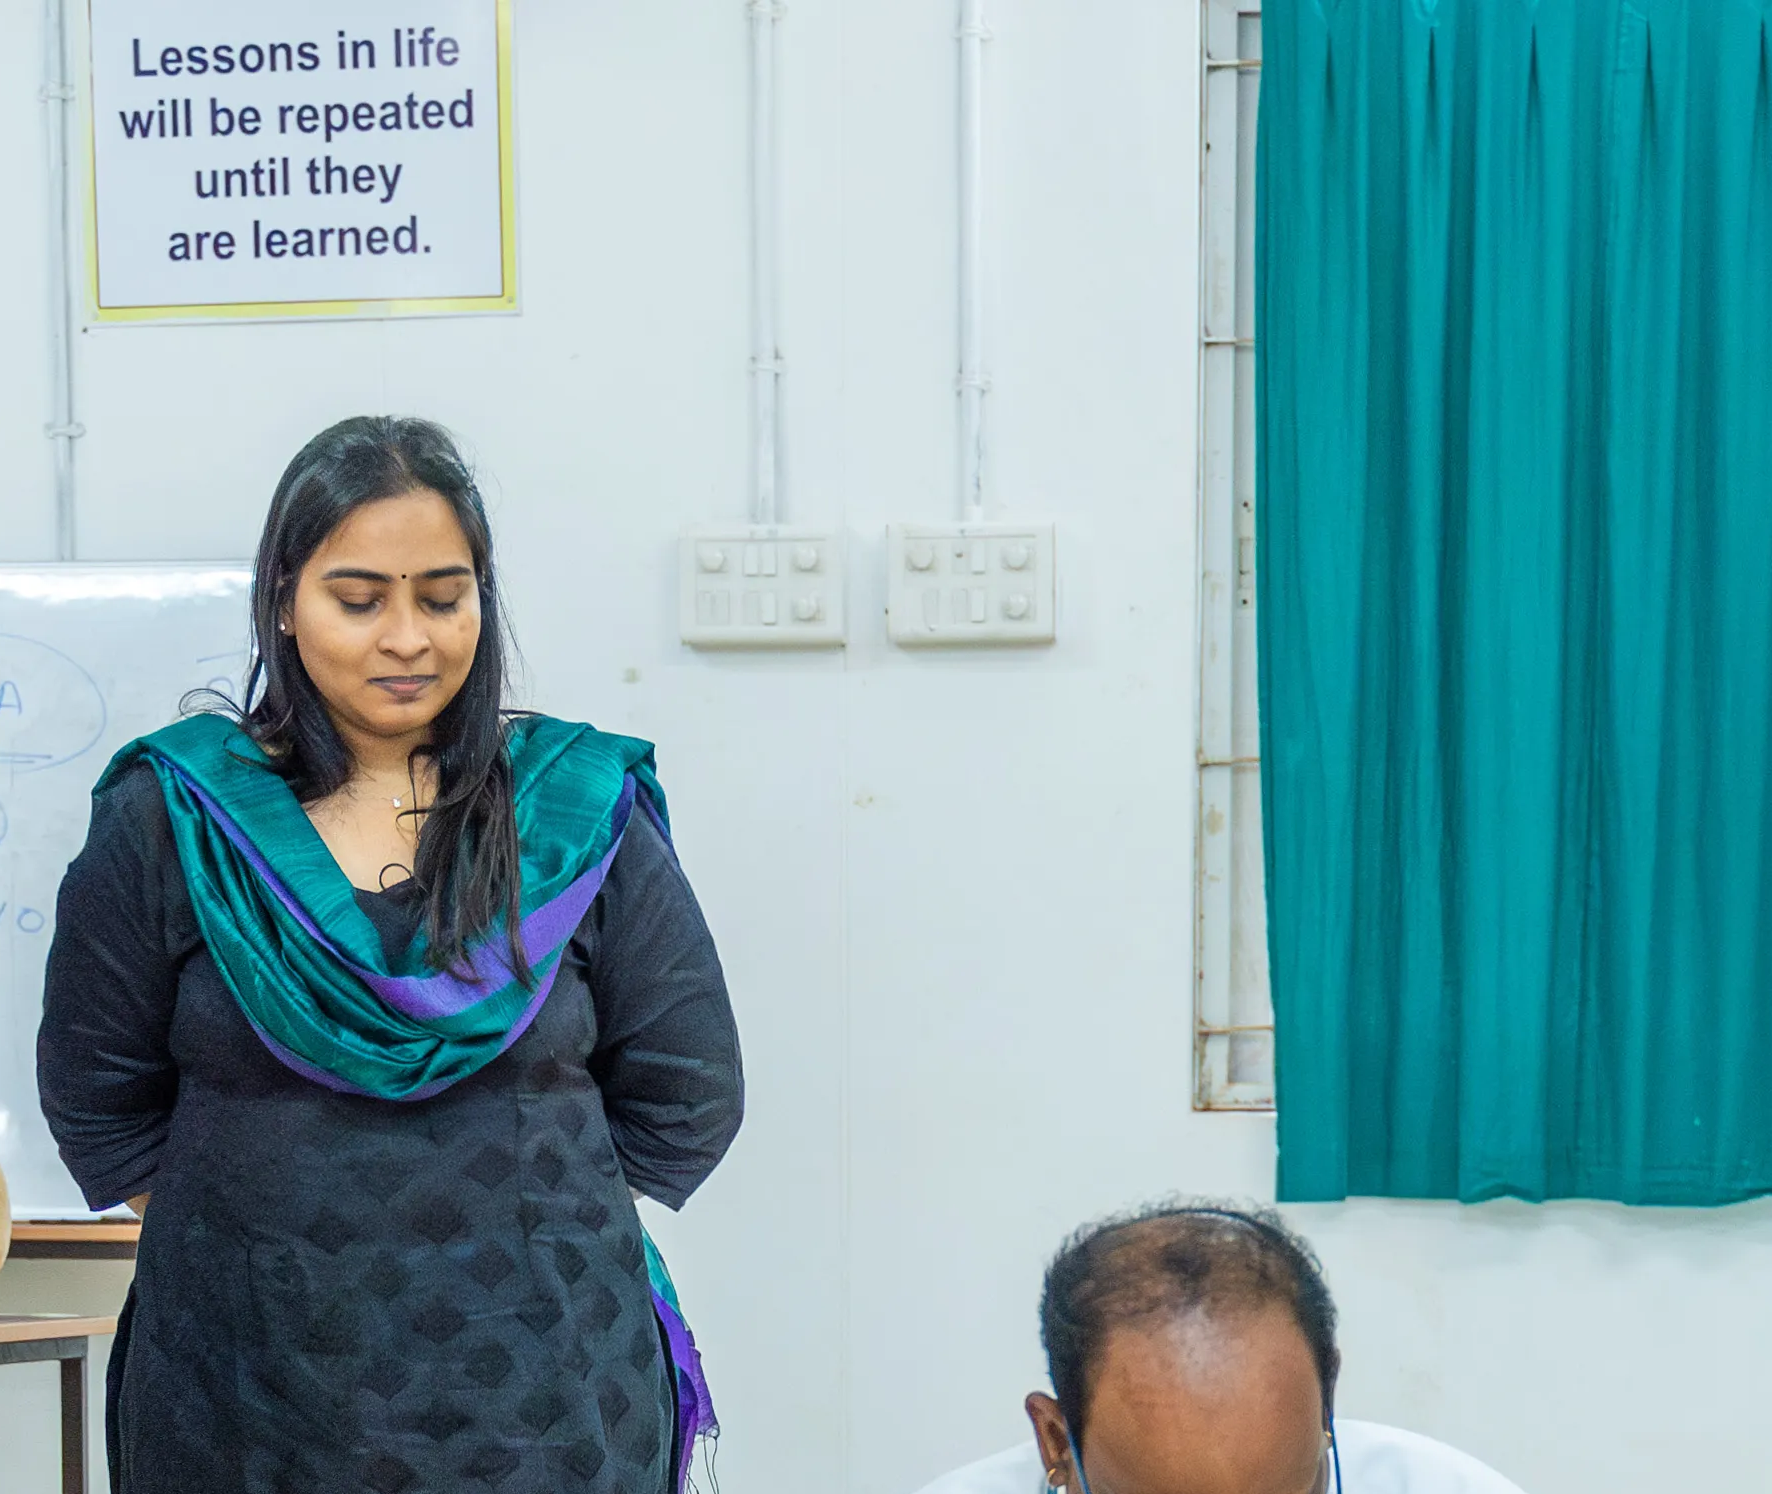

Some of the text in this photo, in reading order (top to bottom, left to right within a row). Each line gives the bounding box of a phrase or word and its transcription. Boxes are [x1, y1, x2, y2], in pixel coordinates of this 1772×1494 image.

[131, 26, 460, 78] Lessons in life
[118, 88, 475, 143] will be repeated
[194, 155, 403, 204] until they
[167, 215, 432, 261] are learned.
